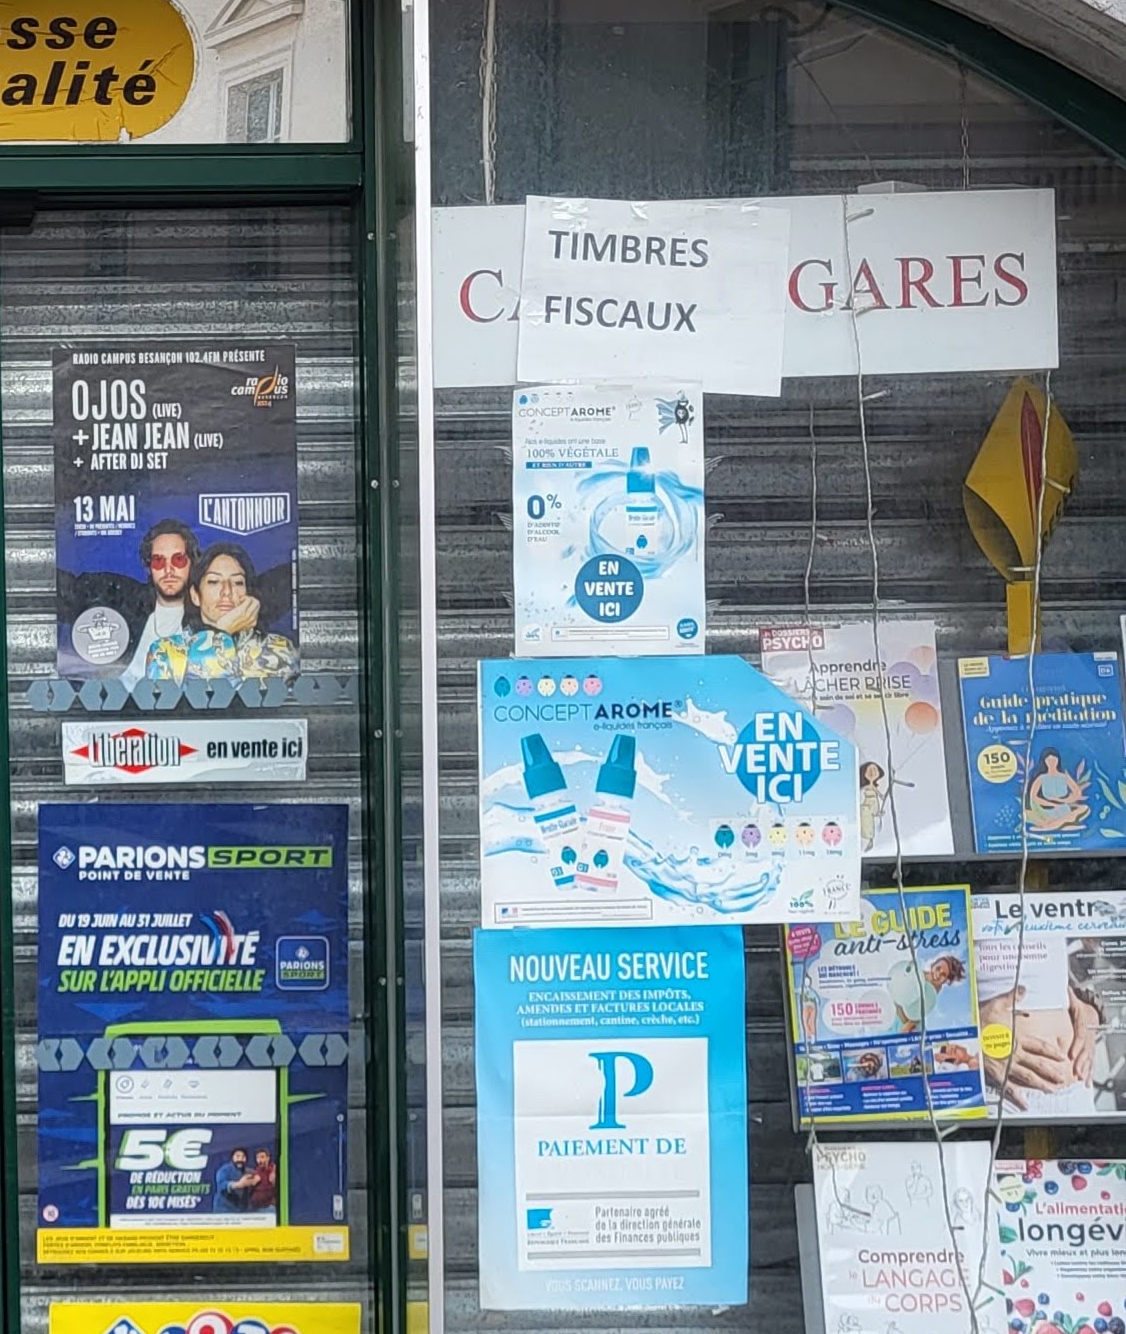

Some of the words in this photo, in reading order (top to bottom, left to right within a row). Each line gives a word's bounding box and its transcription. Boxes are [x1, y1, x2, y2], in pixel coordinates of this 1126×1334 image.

[548, 229, 709, 268] TIMBRES
[544, 295, 698, 333] FISCAUX
[73, 353, 99, 365] RADIO
[101, 352, 136, 365] CAMPUS
[139, 352, 182, 367] BESANÇON
[223, 349, 265, 363] PRÉSENTE
[72, 379, 146, 421] OJOS
[152, 402, 182, 419] (LIVE)
[92, 423, 138, 451] JEAN
[143, 422, 190, 450] JEAN
[194, 432, 224, 450] (LIVE)
[91, 452, 127, 471] AFTER
[130, 452, 144, 470] DJ
[147, 452, 168, 469] SET
[73, 497, 93, 522] 13
[100, 495, 135, 522] MAI
[598, 561, 619, 575] EN
[584, 581, 634, 596] VENTE
[599, 602, 620, 617] ICI
[755, 712, 803, 742] EN
[88, 733, 180, 768] Libération
[206, 743, 228, 758] en
[230, 739, 278, 758] vente
[281, 737, 303, 758] ici
[718, 741, 840, 775] VENTE
[983, 752, 1011, 765] 150
[757, 773, 803, 804] ICI
[78, 846, 206, 868] PARIONS
[211, 848, 331, 867] SPORT
[58, 914, 77, 928] DU
[78, 914, 92, 928] 19
[93, 914, 119, 927] JUIN
[121, 914, 136, 927] AU
[137, 914, 149, 927] 31
[151, 913, 193, 927] JUILLET
[871, 903, 952, 935] GUIDE
[57, 935, 94, 966] EN
[99, 930, 260, 966] EXCLUSIVITÉ
[834, 929, 961, 956] anti-stress
[509, 953, 612, 983] NOUVEAU
[617, 951, 709, 980] SERVICE
[57, 969, 94, 993] SUR
[101, 969, 165, 992] L'APPLI
[169, 968, 265, 992] OFFICIELLE
[528, 990, 618, 1002] ENCAISSEMENT
[619, 990, 640, 1001] DES
[516, 1003, 573, 1015] AMENDES
[574, 1003, 588, 1014] ET
[590, 1002, 650, 1014] FACTURES
[652, 1001, 704, 1013] LOCALES
[114, 1128, 213, 1171] 5€
[537, 1138, 650, 1157] PAIEMENT
[656, 1137, 687, 1156] DE
[594, 1205, 642, 1219] Partenaire
[644, 1204, 670, 1219] agréé
[595, 1220, 606, 1231] de
[608, 1220, 618, 1230] la
[620, 1219, 660, 1231] direction
[662, 1218, 702, 1232] générale
[595, 1233, 613, 1244] des
[614, 1232, 655, 1244] Finances
[656, 1231, 701, 1246] publiques
[858, 1249, 965, 1267] Comprendre
[884, 1294, 963, 1313] CORPS
